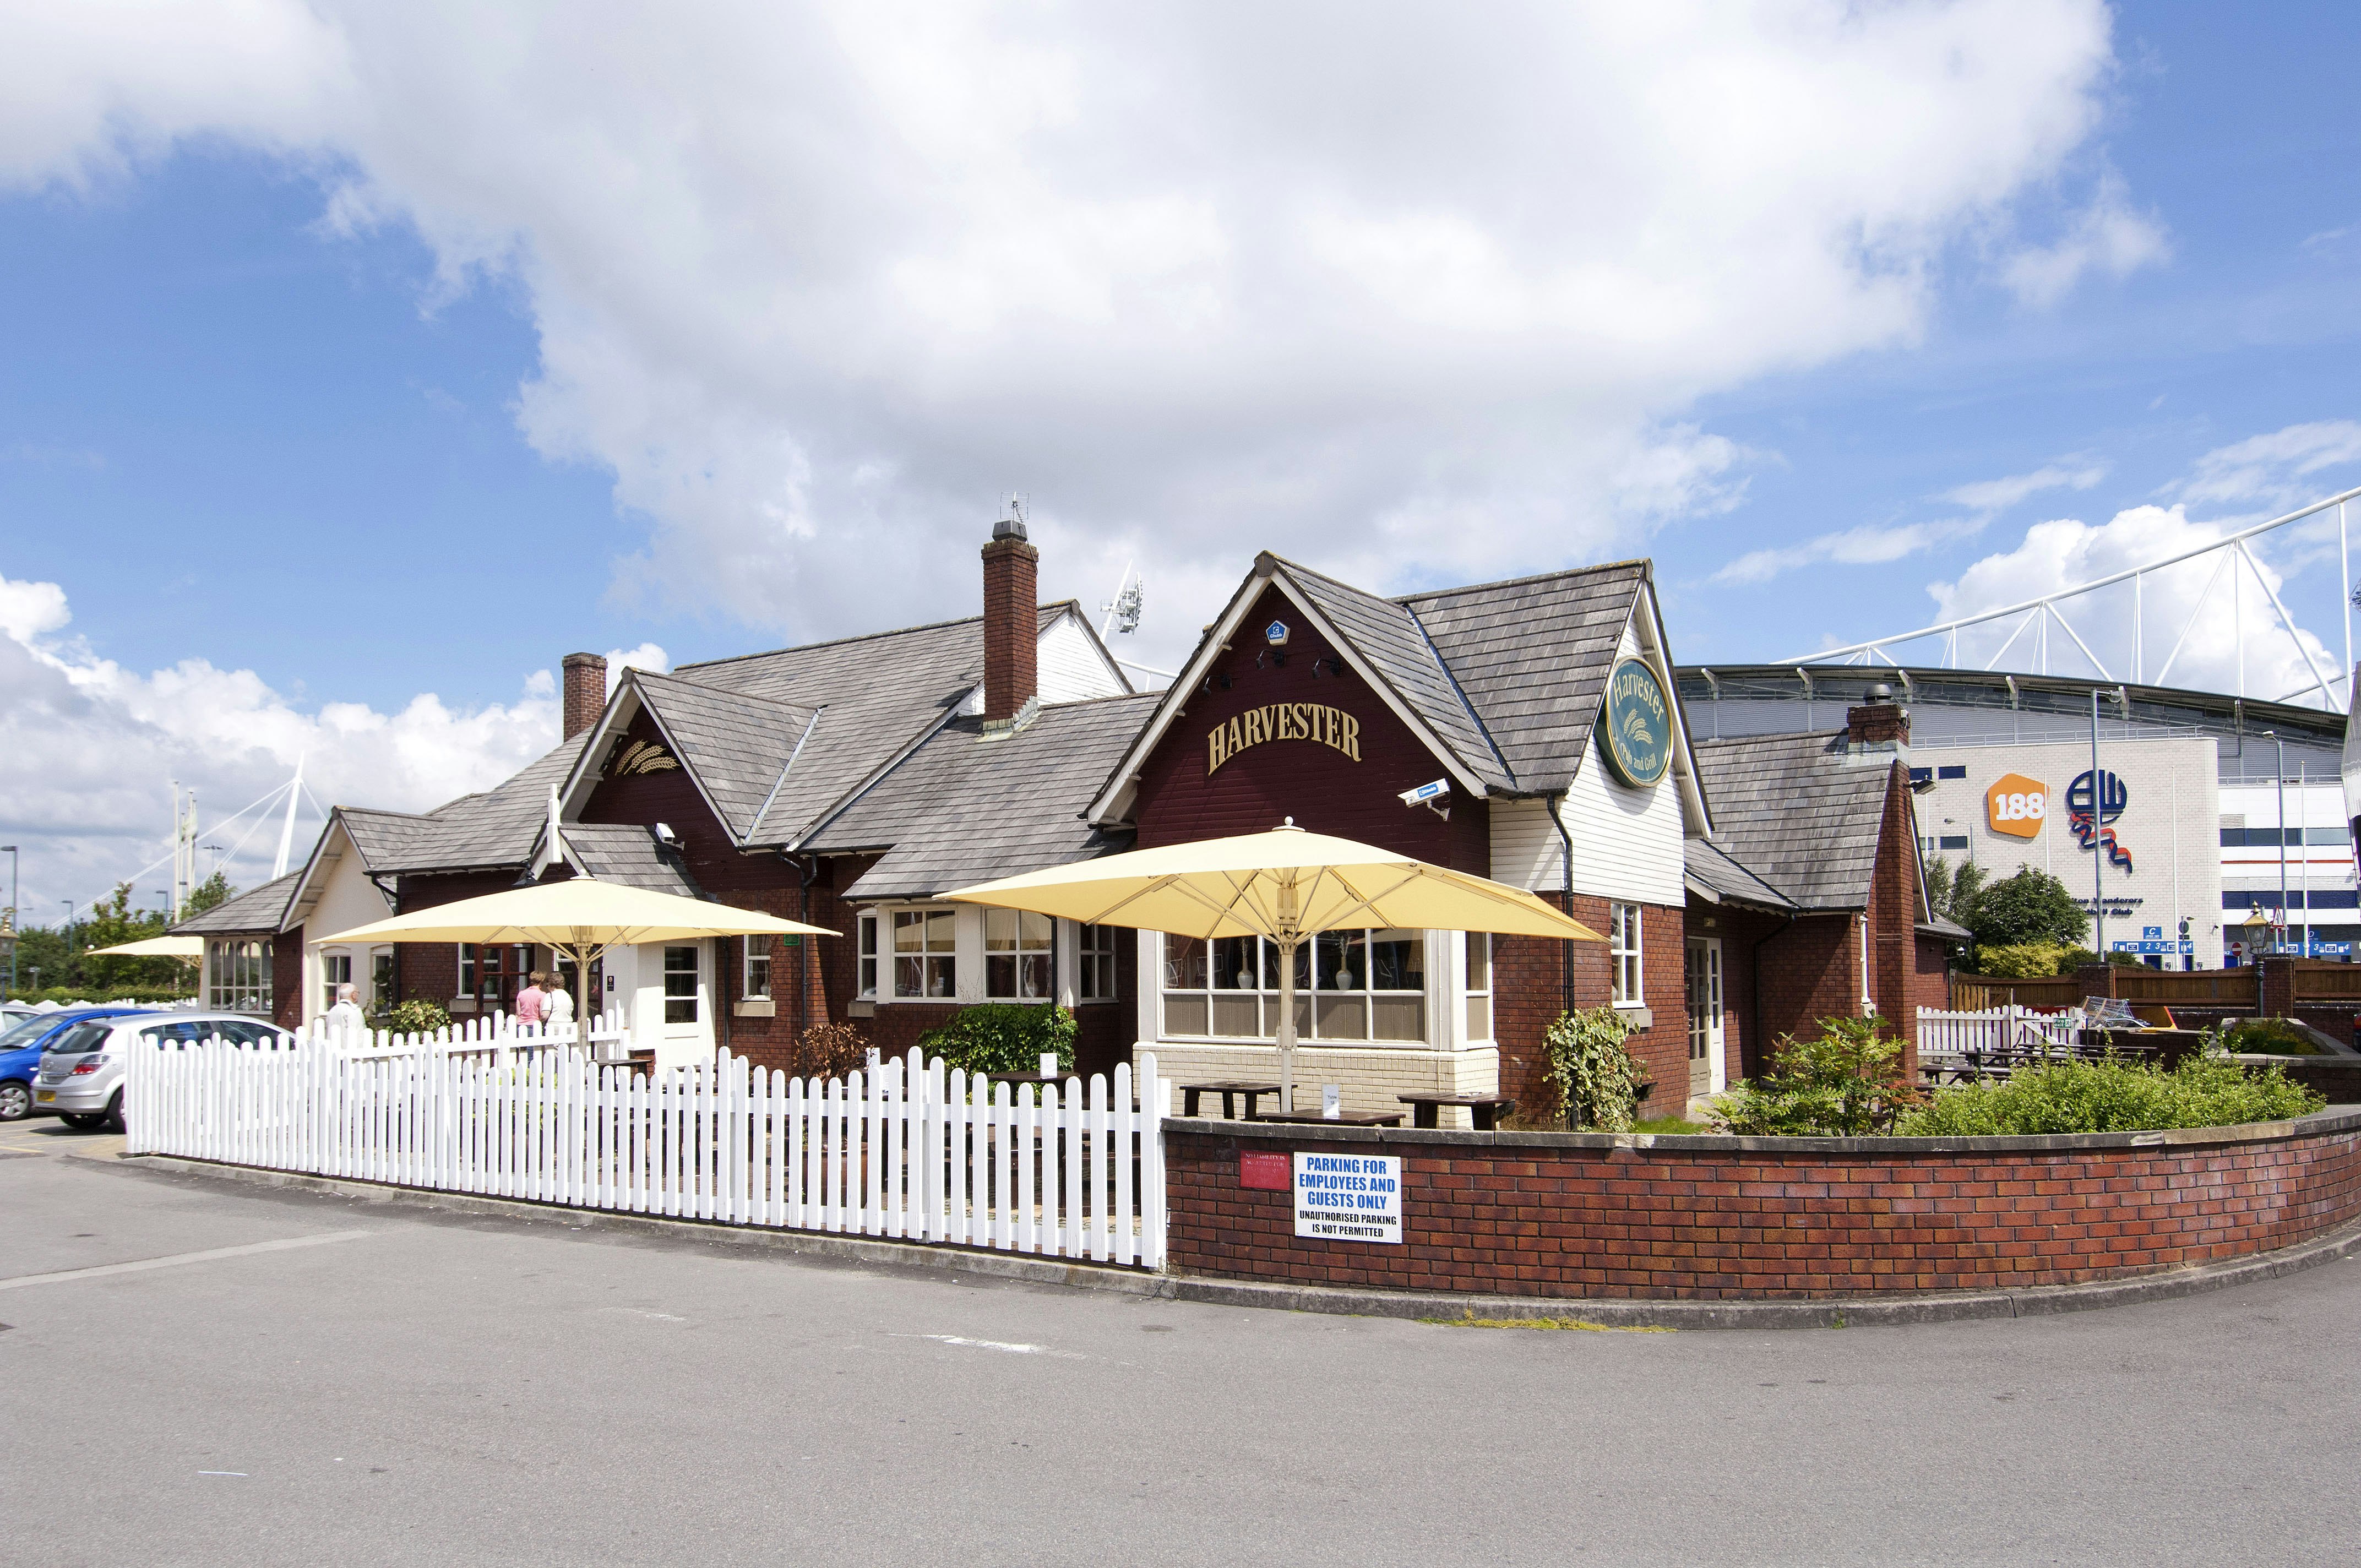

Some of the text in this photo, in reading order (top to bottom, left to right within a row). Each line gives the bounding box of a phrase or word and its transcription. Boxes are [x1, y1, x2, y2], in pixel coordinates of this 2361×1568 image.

[1613, 673, 1664, 723] Harvester
[1208, 703, 1362, 776] HARVESTER
[1634, 756, 1645, 771] and
[1645, 753, 1657, 771] Grill
[1995, 792, 2046, 821] 188
[1307, 1157, 1386, 1174] PARKING FOR
[1299, 1173, 1395, 1193] EMPLOYEES AND
[1308, 1191, 1387, 1210] GUESTS ONLY
[1299, 1210, 1397, 1225] UNAUTHORISED PARKING
[1312, 1223, 1384, 1237] IS NOT PERMITTED
